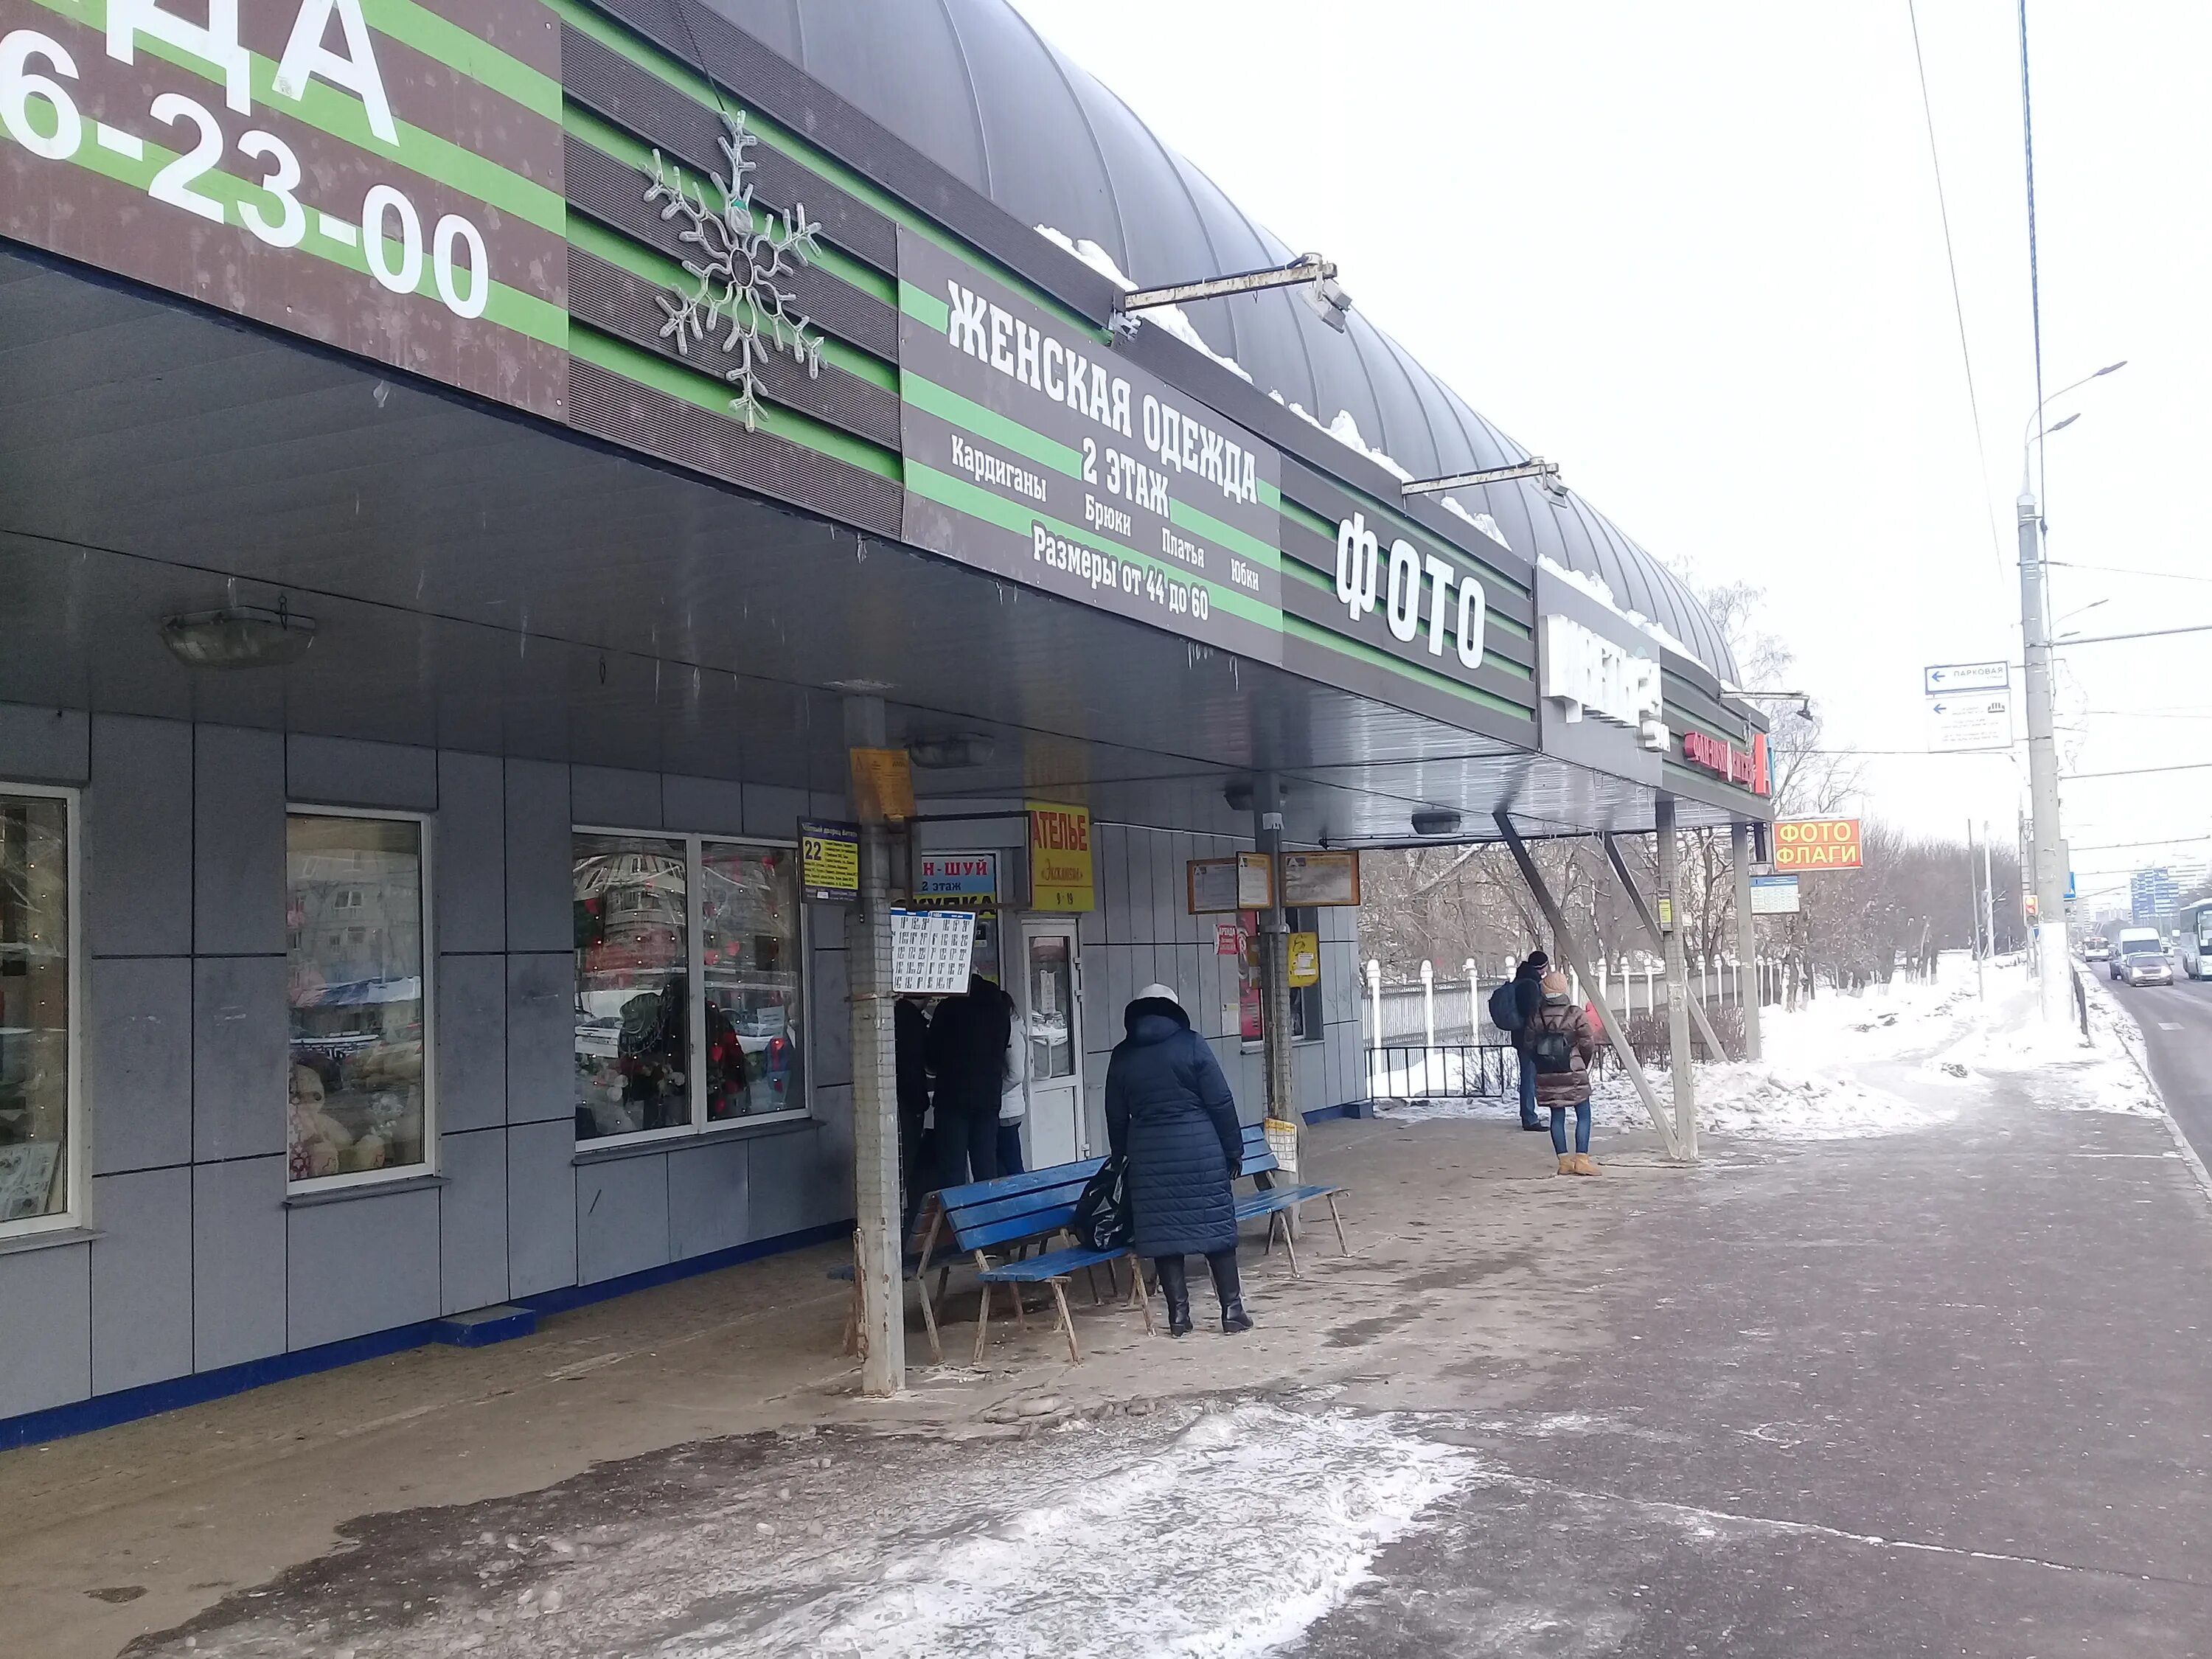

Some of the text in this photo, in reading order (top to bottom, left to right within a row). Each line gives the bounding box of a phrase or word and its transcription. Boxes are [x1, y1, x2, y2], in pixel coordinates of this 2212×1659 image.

[947, 279, 1258, 505] ЖЕНСКАЯ ОДЕЖДА
[951, 434, 1046, 502] Кардиганы
[1082, 437, 1169, 518] 2 ЭТАЖ
[1085, 493, 1132, 537] Брюки
[1161, 526, 1205, 568] Платья
[1033, 525, 1209, 621] Размеры от 44 до 60
[1231, 557, 1260, 592] Юбки
[1336, 511, 1486, 669] ФОТО
[1953, 667, 2003, 676] ПАРКОВАЯ
[804, 840, 822, 861] 22
[1031, 810, 1088, 852] АТЕЛЬЕ
[1779, 822, 1851, 843] ФОТО
[1776, 844, 1857, 864] ФЛАГИ
[922, 881, 961, 891] 2 этаж
